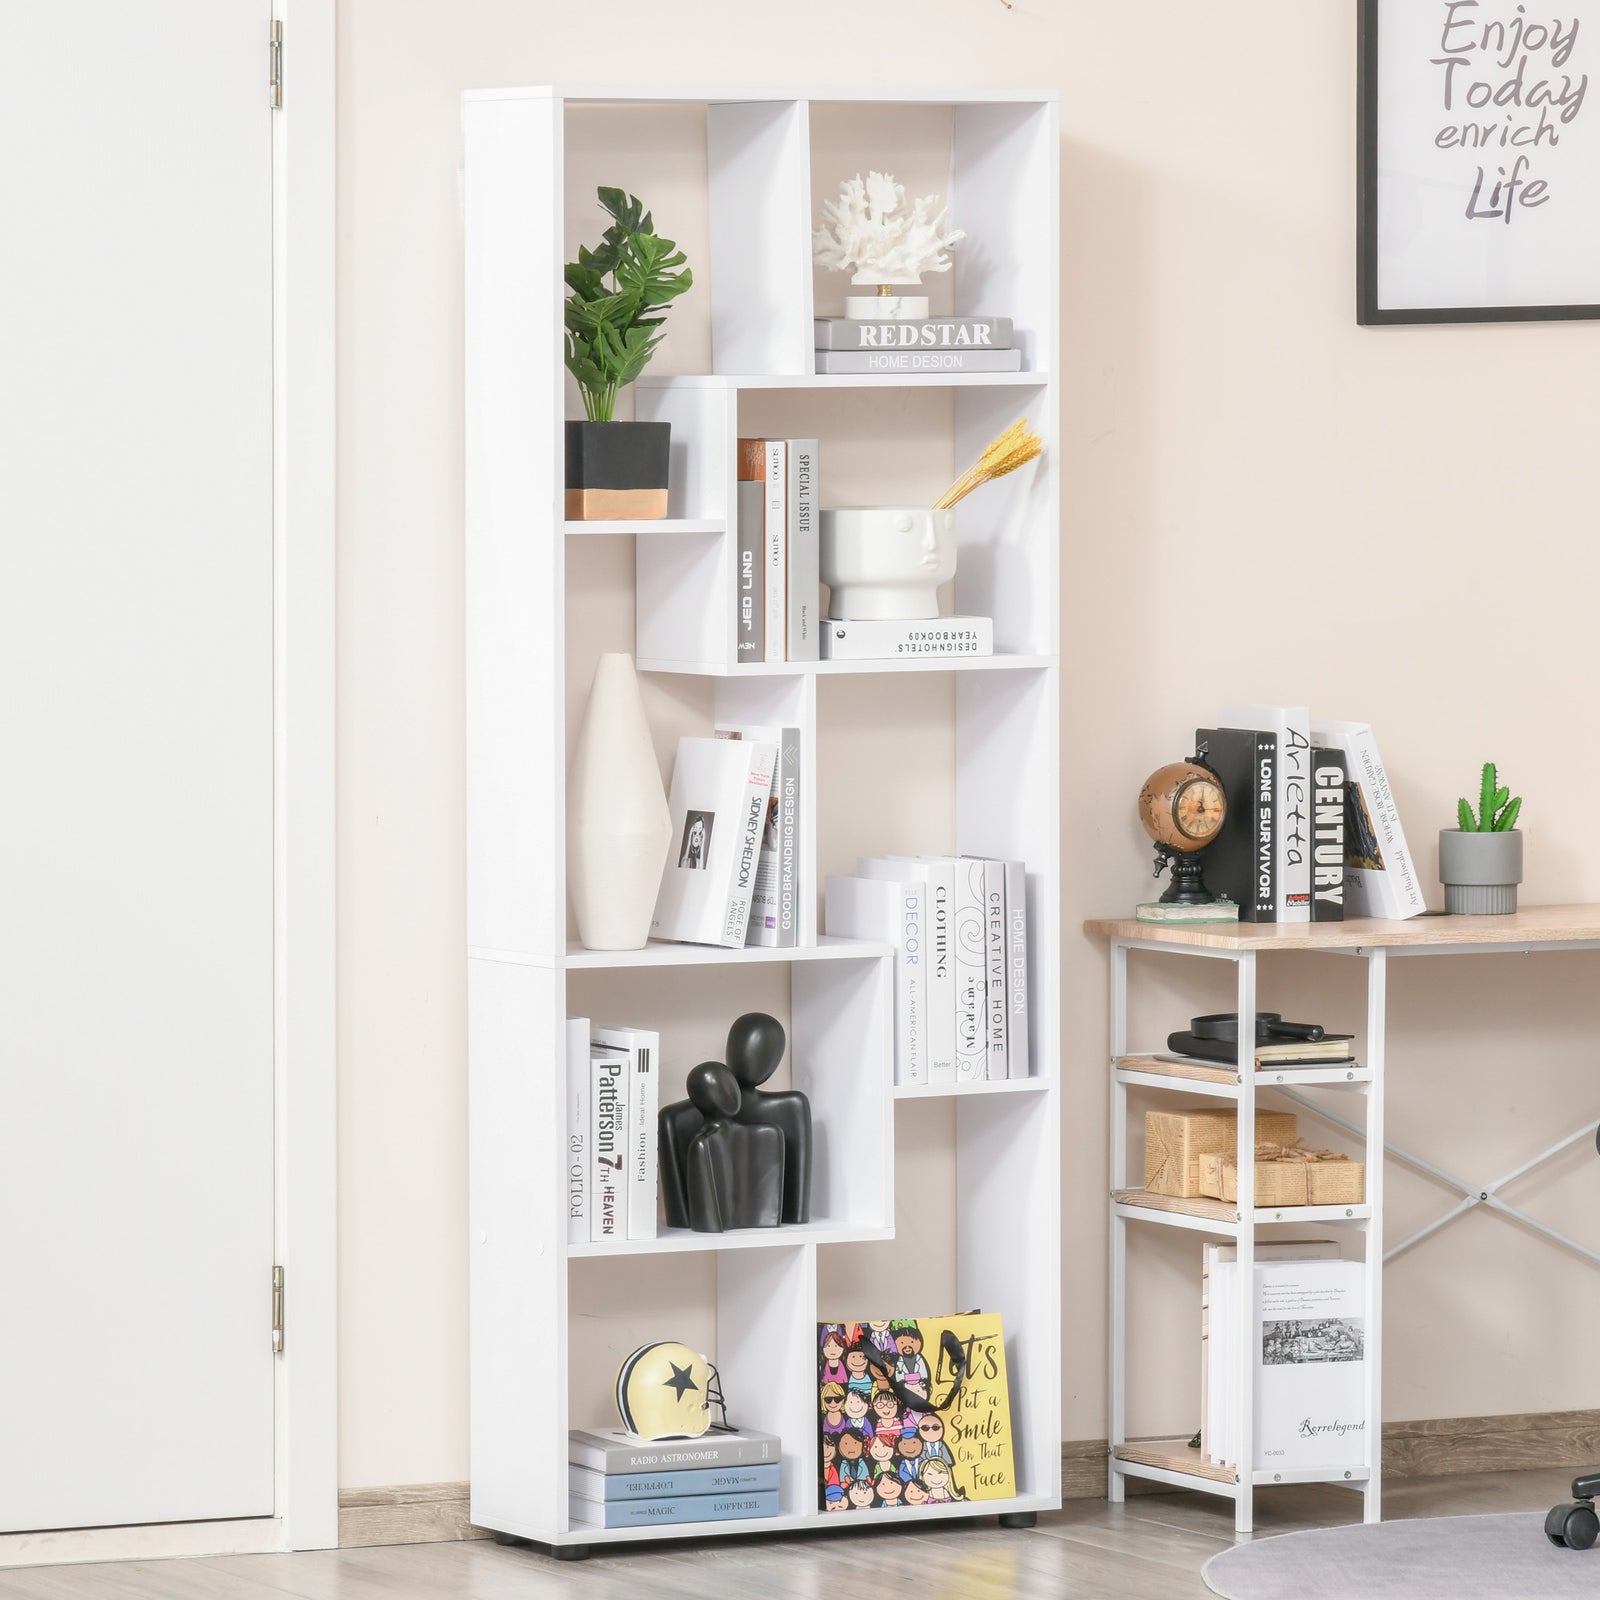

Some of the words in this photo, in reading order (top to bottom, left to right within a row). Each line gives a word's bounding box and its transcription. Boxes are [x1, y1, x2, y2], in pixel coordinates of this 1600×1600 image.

[1441, 0, 1579, 68] Enjoy
[1429, 55, 1588, 124] Today
[1435, 106, 1559, 148] enrich
[1465, 155, 1550, 224] Life
[858, 323, 992, 347] REDSTAR
[869, 356, 909, 369] HOME
[912, 355, 963, 368] DESIGN
[799, 454, 810, 498] SPECIAL
[799, 502, 810, 532] ISSUE
[742, 550, 753, 590] LIND
[742, 596, 753, 631] JED
[784, 777, 795, 825] DESIGN
[1259, 758, 1272, 802] LONE
[745, 796, 762, 835] SIDNEY
[1314, 766, 1344, 905] CENTURY
[738, 836, 755, 888] SHELDON
[1259, 807, 1272, 899] SURVIVOR
[727, 901, 738, 936] ANGELS
[783, 893, 792, 930] GOOD
[905, 897, 919, 965] DECOR
[935, 886, 947, 979] CLOTHING
[1012, 908, 1024, 953] HOME
[734, 928, 742, 941] OF
[989, 892, 1002, 988] CREATIVE
[1013, 957, 1025, 1014] DESIGN
[991, 999, 1003, 1052] HOME
[598, 1064, 622, 1152] Patterson
[615, 1101, 626, 1131] James
[570, 1134, 584, 1153] 02
[637, 1132, 647, 1183] Fashion
[570, 1165, 583, 1219] FOLIO
[602, 1186, 615, 1235] HEAVEN
[957, 1386, 987, 1412] Put
[989, 1397, 1000, 1407] a
[951, 1410, 1002, 1444] Smile
[630, 1455, 658, 1466] RADIO
[660, 1450, 720, 1463] ASTRONOMER
[958, 1447, 974, 1463] On
[978, 1442, 1007, 1460] That
[712, 1476, 740, 1486] MAGIC
[648, 1506, 676, 1516] MAGIC
[713, 1501, 760, 1512] L'OFFICIEL
